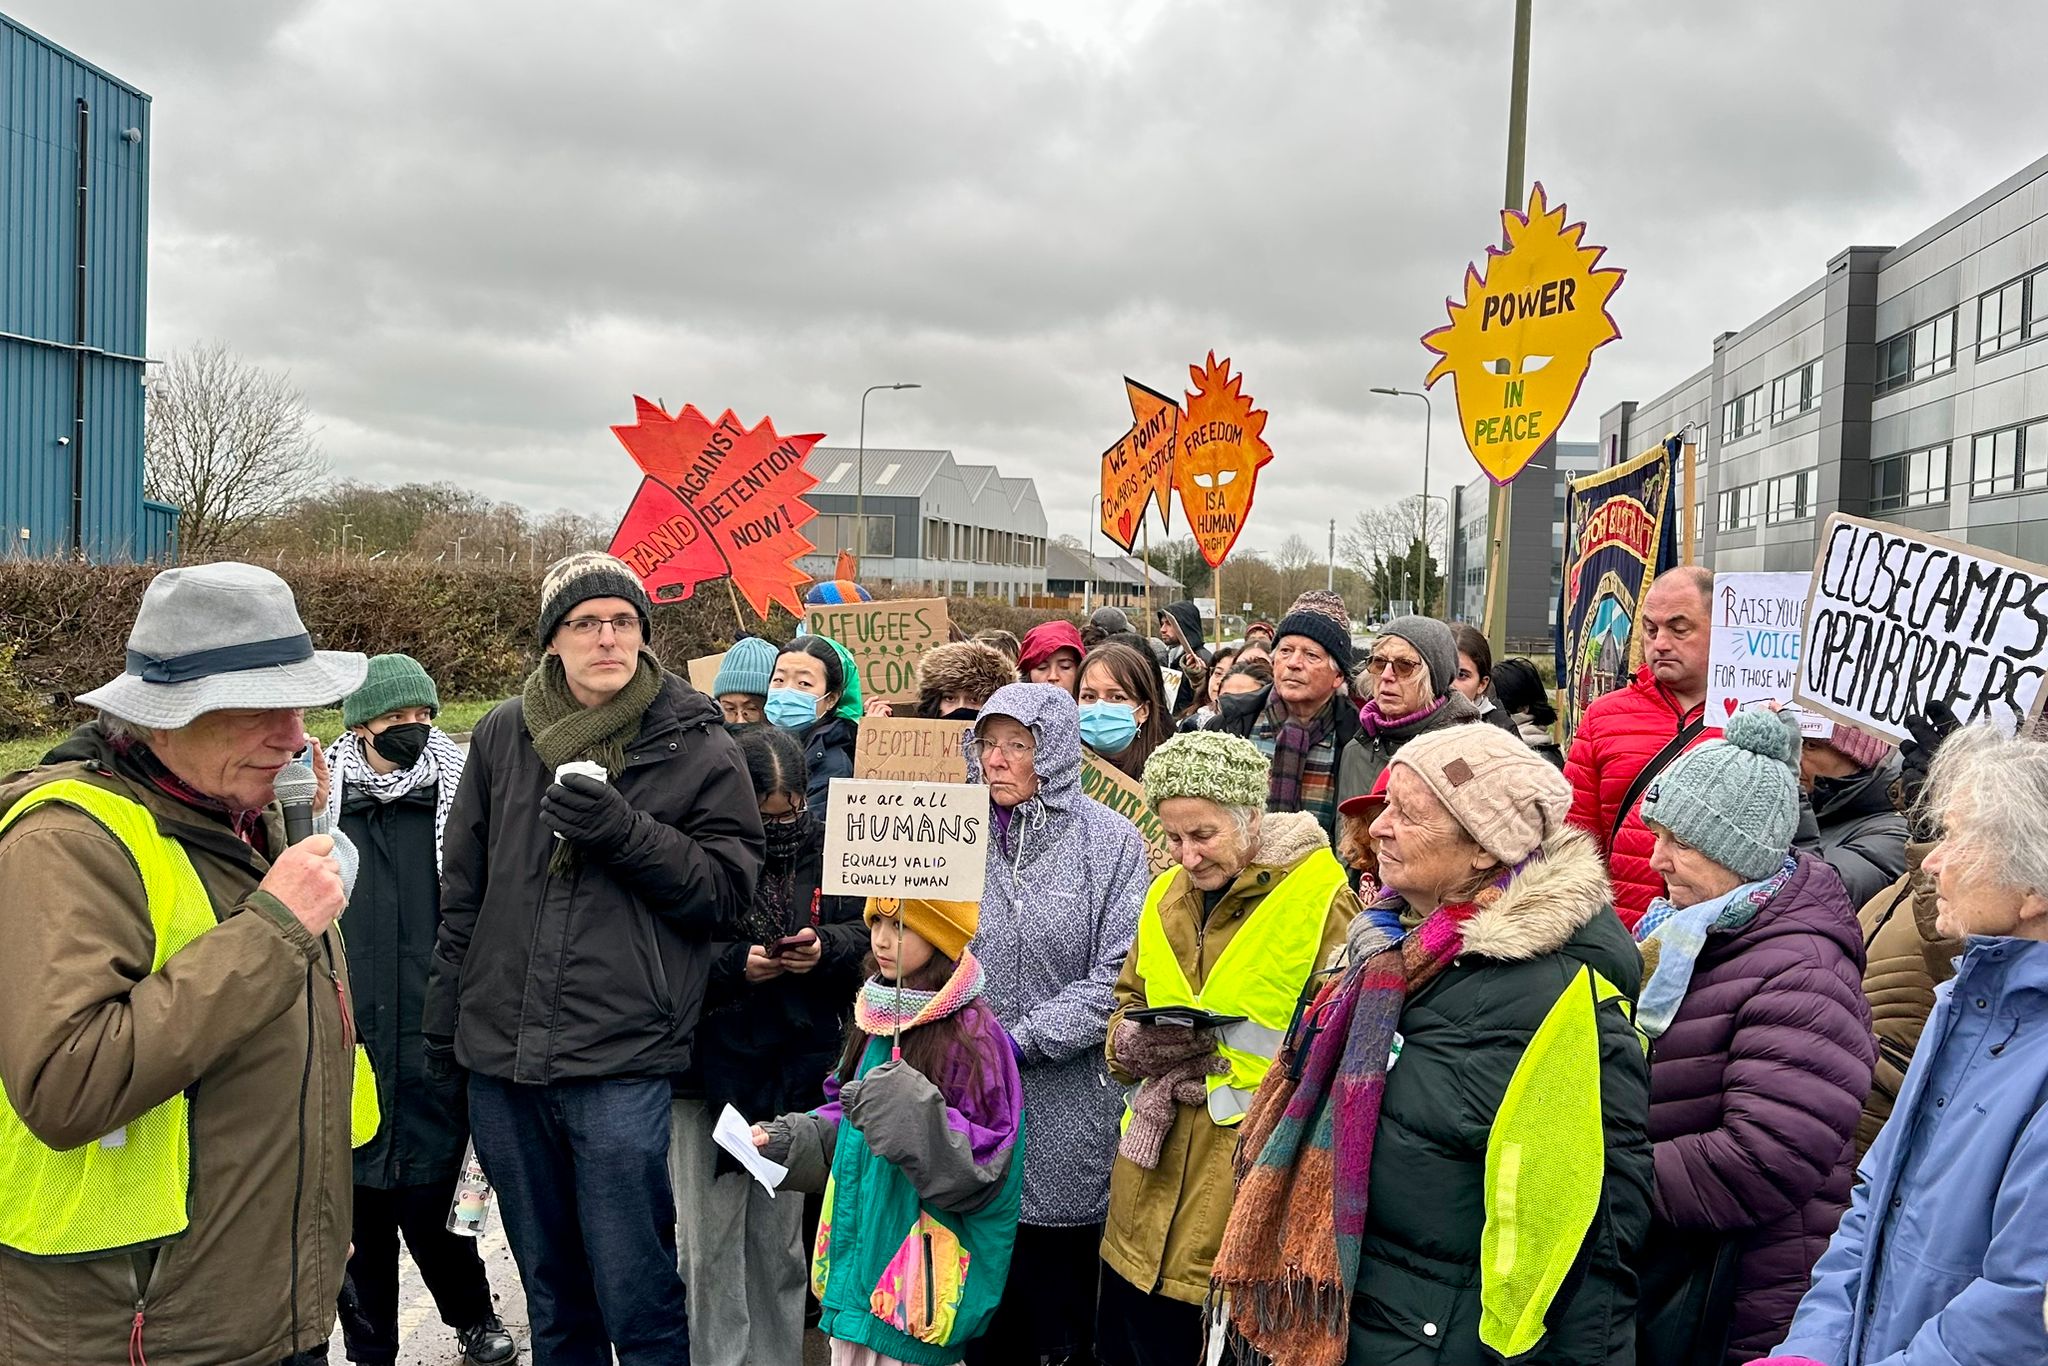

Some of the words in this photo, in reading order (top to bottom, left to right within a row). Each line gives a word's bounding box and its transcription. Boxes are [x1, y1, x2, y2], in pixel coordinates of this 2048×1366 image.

[1481, 277, 1576, 332] POWER
[1504, 380, 1524, 409] IN
[1109, 443, 1127, 475] WE
[1133, 406, 1167, 457] POINT
[1184, 421, 1243, 457] FREEDOM
[1475, 411, 1542, 446] PEACE
[676, 419, 742, 504] AGAINST
[1140, 438, 1174, 484] JUSTICE
[699, 441, 801, 528] DETENTION
[730, 504, 794, 550] NOW!
[1197, 513, 1236, 534] HUMAN
[618, 514, 699, 579] TAND
[1203, 536, 1227, 551] RIGHT
[1725, 592, 1772, 627] RAISE
[811, 608, 932, 647] REFUGEES
[1746, 630, 1801, 660] VOICE
[1714, 664, 1736, 688] FOR
[1740, 668, 1773, 688] THOSE
[866, 728, 932, 757] PEOPLE
[877, 794, 904, 807] are
[914, 792, 947, 808] all
[847, 813, 980, 845] HUMANS
[842, 852, 897, 869] EQUALLY
[904, 857, 946, 868] VALID
[842, 872, 896, 886] EQUALLY
[904, 875, 949, 887] HUMAN
